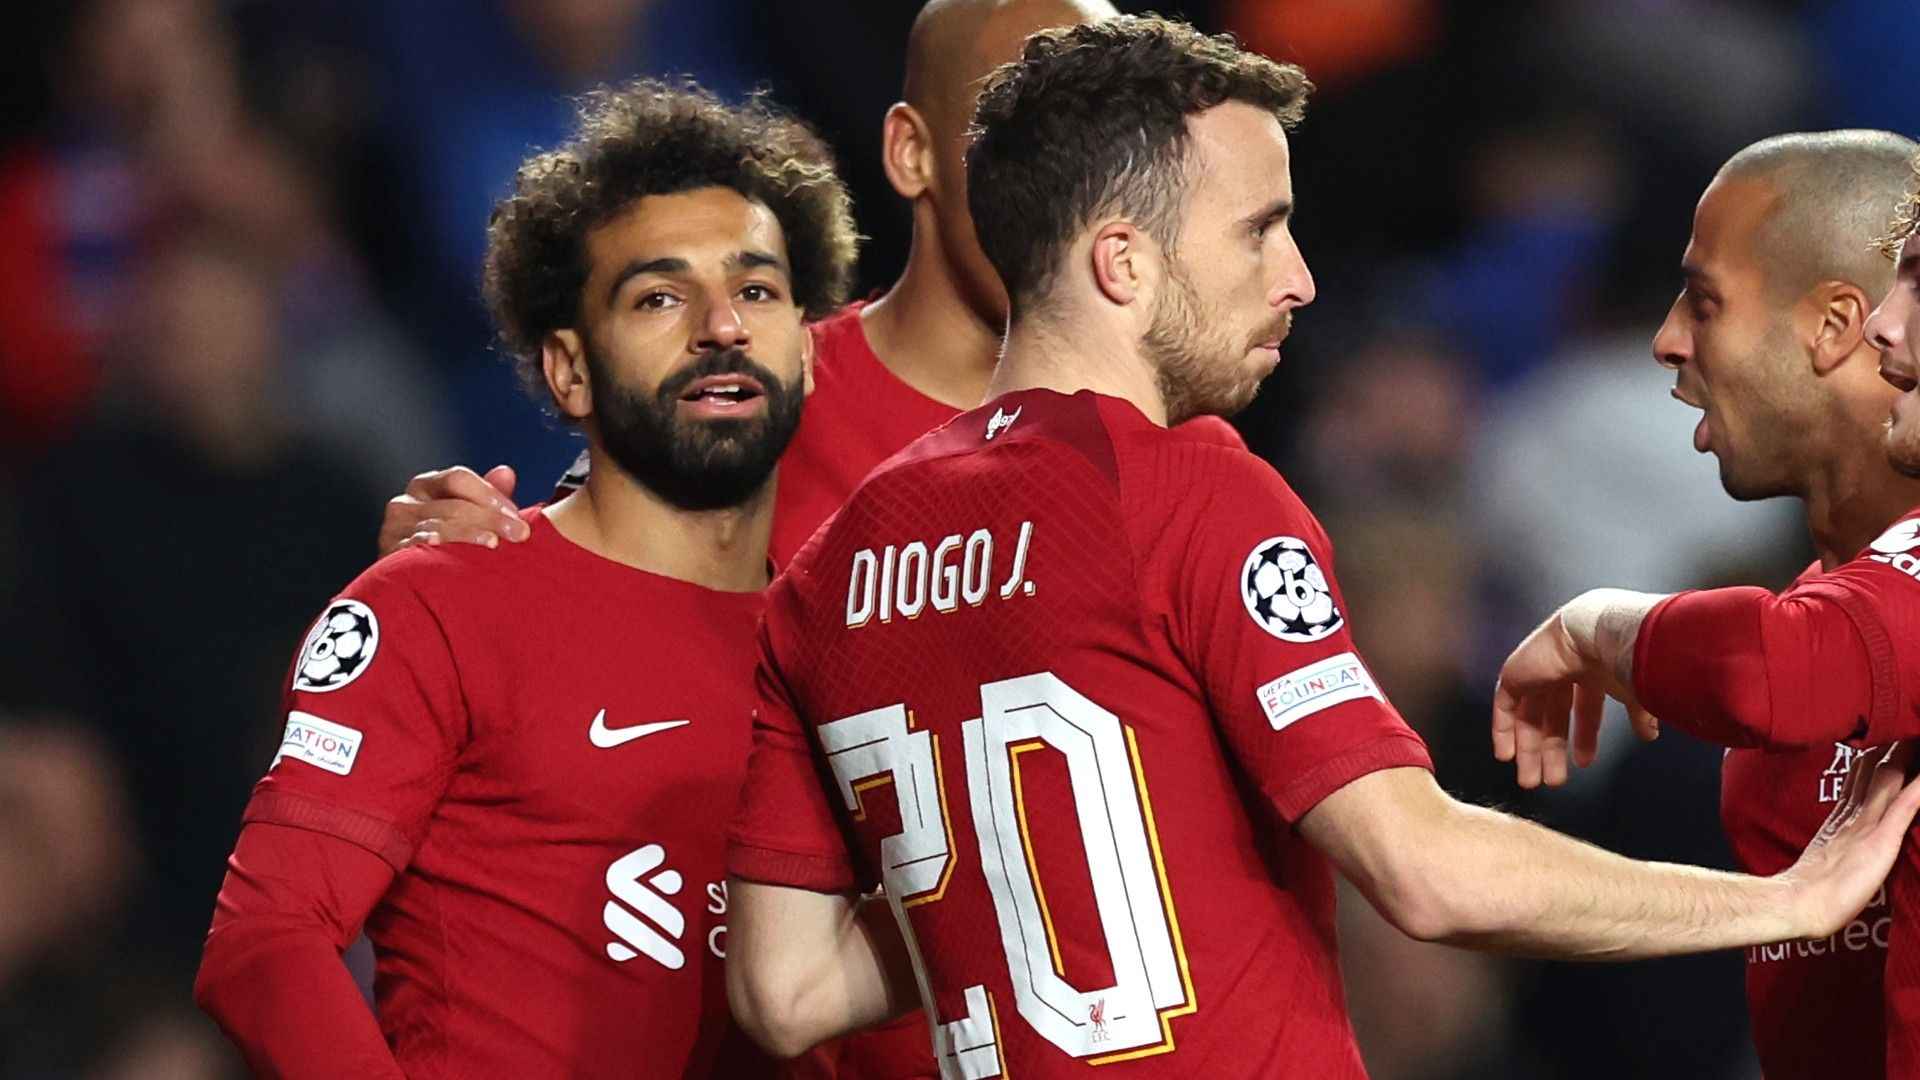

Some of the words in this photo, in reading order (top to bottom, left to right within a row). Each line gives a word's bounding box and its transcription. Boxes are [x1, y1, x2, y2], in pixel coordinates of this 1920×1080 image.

[846, 528, 993, 629] DIOGO
[1000, 521, 1035, 600] J.
[1284, 569, 1316, 607] 6
[284, 727, 352, 757] ATION
[818, 671, 1197, 1080] 20
